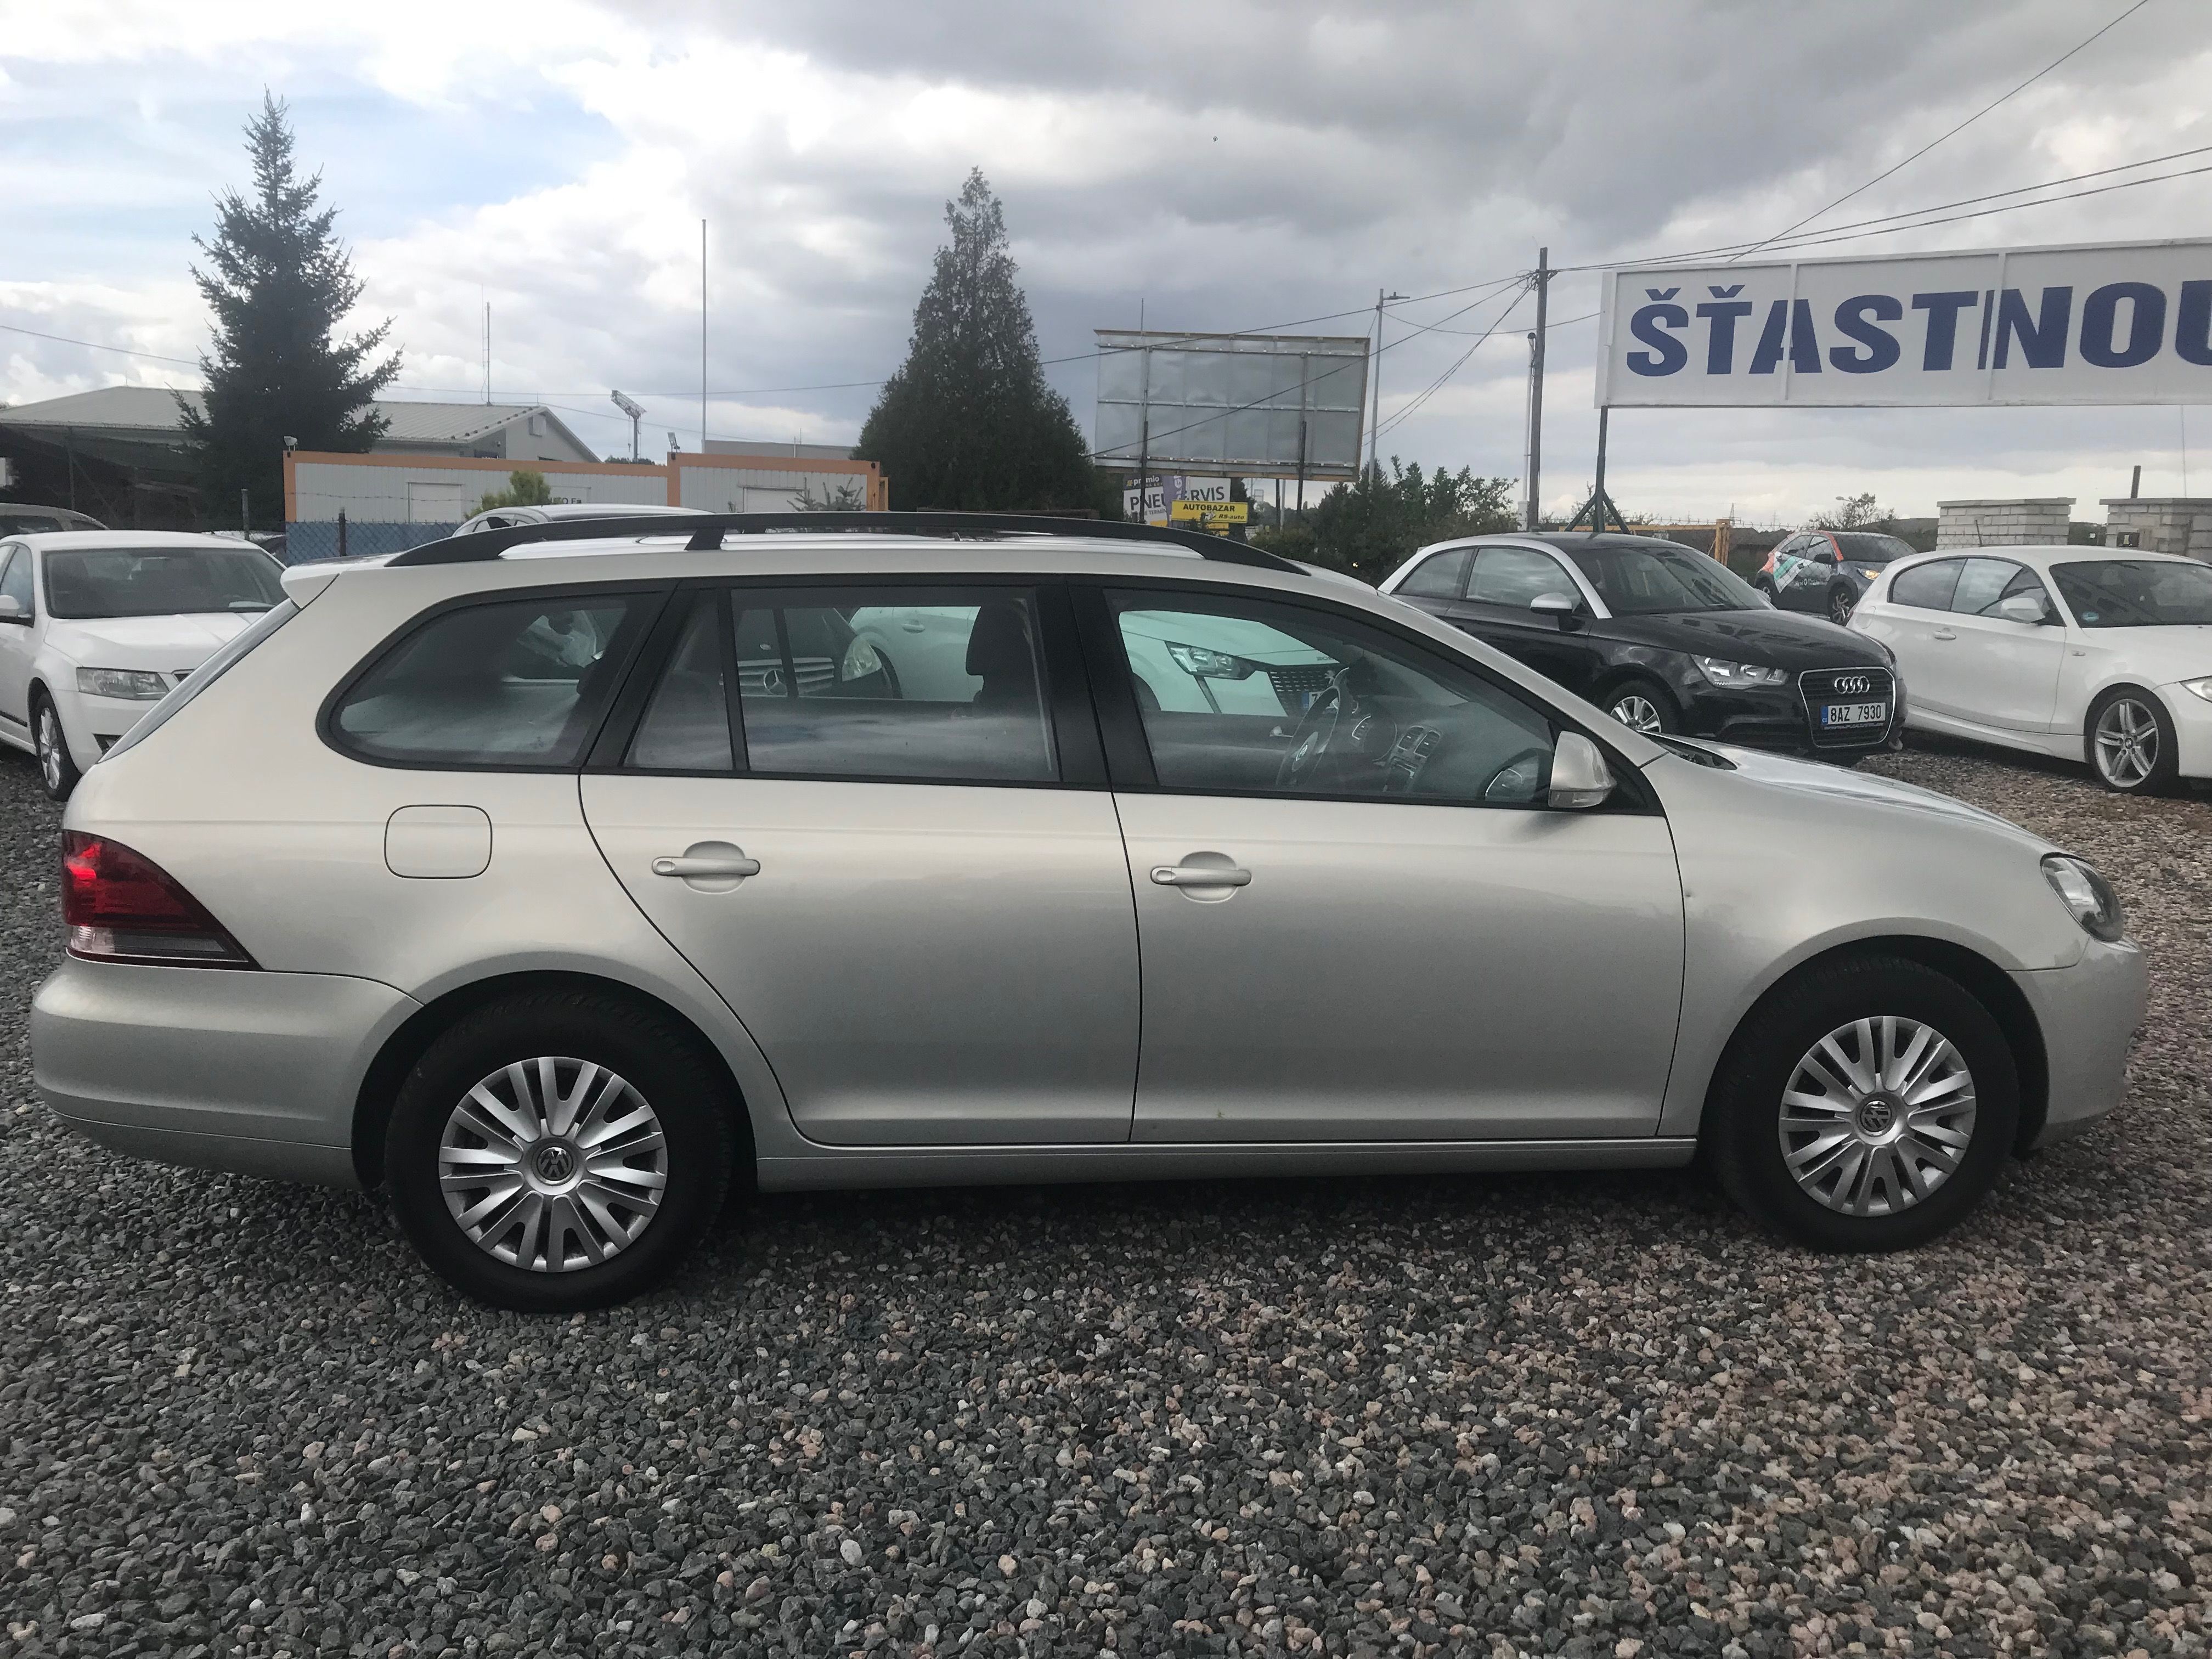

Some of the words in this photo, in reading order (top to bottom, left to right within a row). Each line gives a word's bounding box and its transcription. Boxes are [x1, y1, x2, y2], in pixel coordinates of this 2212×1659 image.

[1133, 475, 1160, 486] prmio
[1830, 707, 1850, 722] 8AZ
[1858, 705, 1881, 721] 7930
